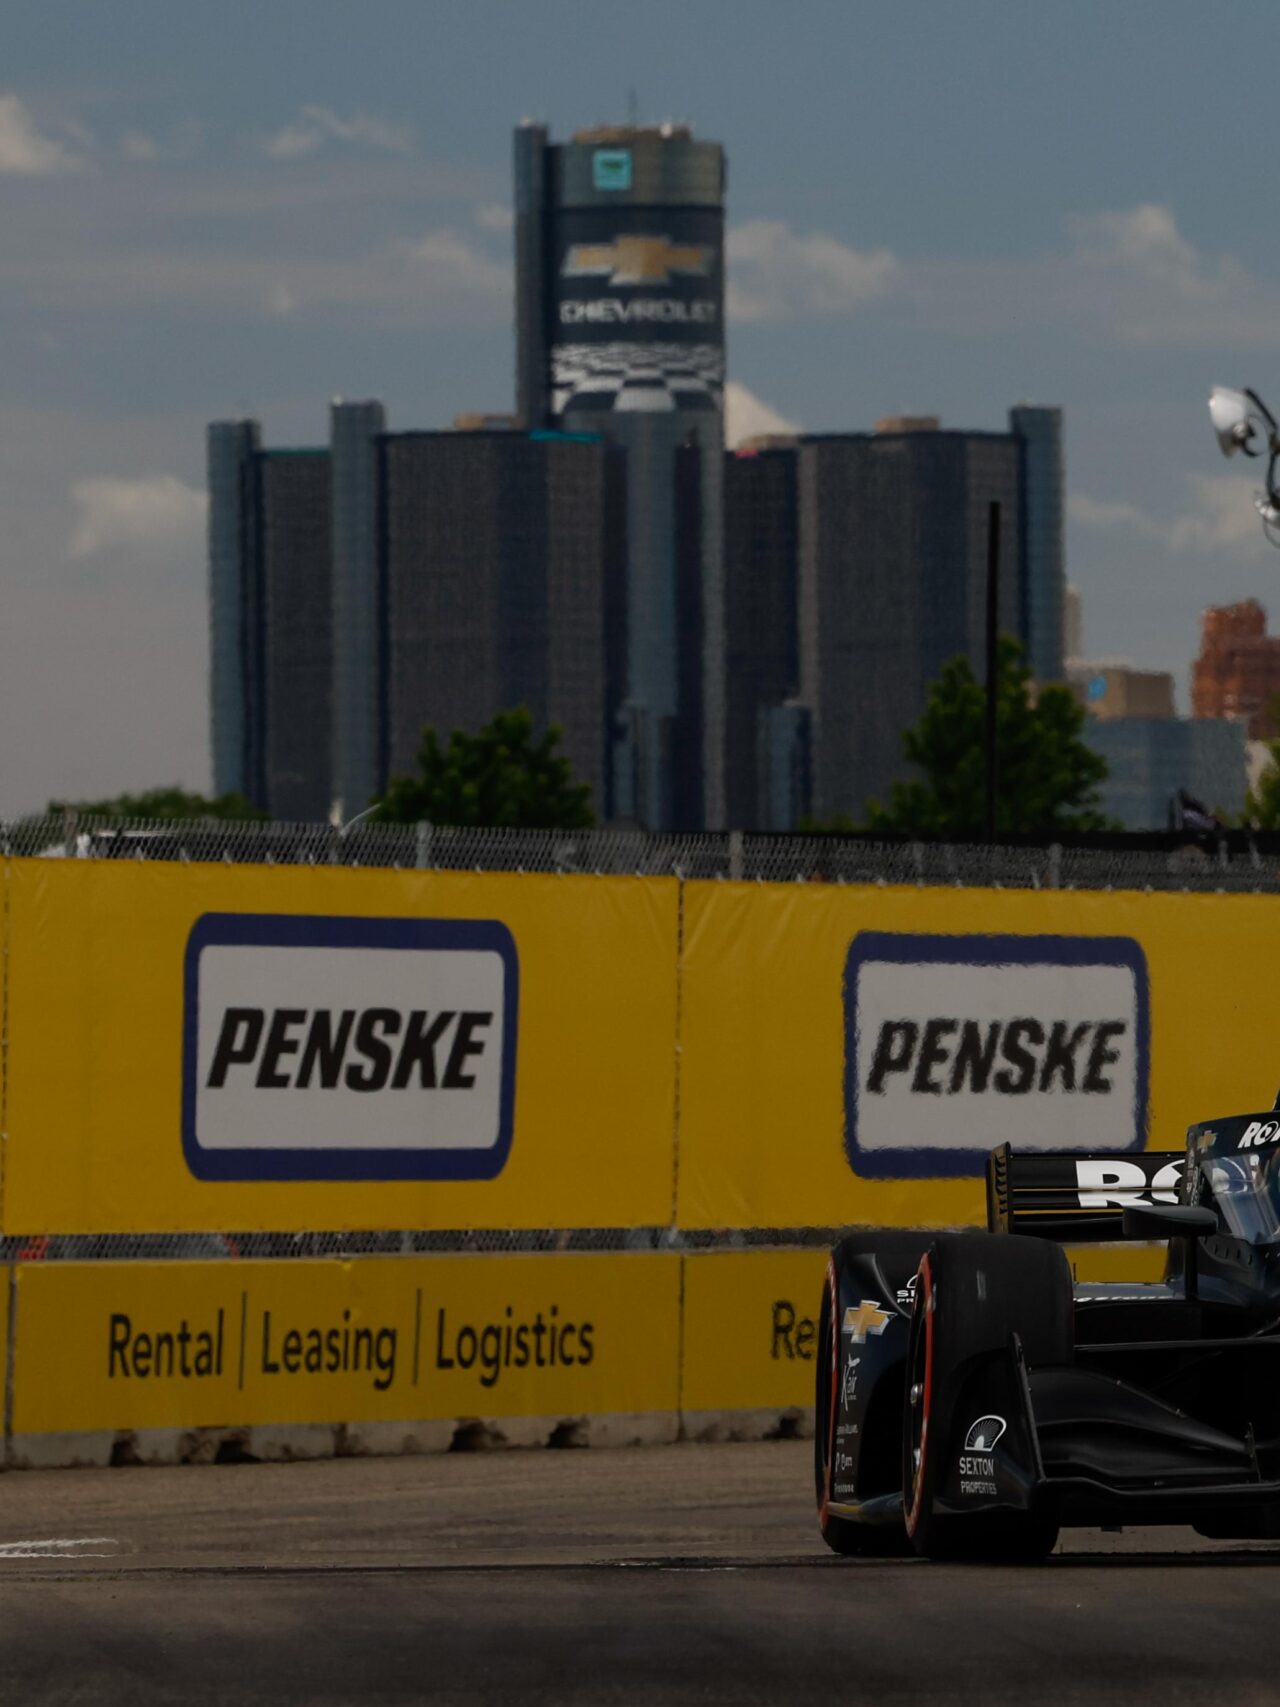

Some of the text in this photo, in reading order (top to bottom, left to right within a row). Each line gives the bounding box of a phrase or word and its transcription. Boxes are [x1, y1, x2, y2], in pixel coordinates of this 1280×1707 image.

[559, 299, 715, 323] CHEVROLET
[206, 1007, 493, 1092] PENSKE
[866, 1017, 1126, 1095] PENSKE
[108, 1305, 595, 1391] Rental Leasing Logistics
[959, 1456, 995, 1477] SEXTON
